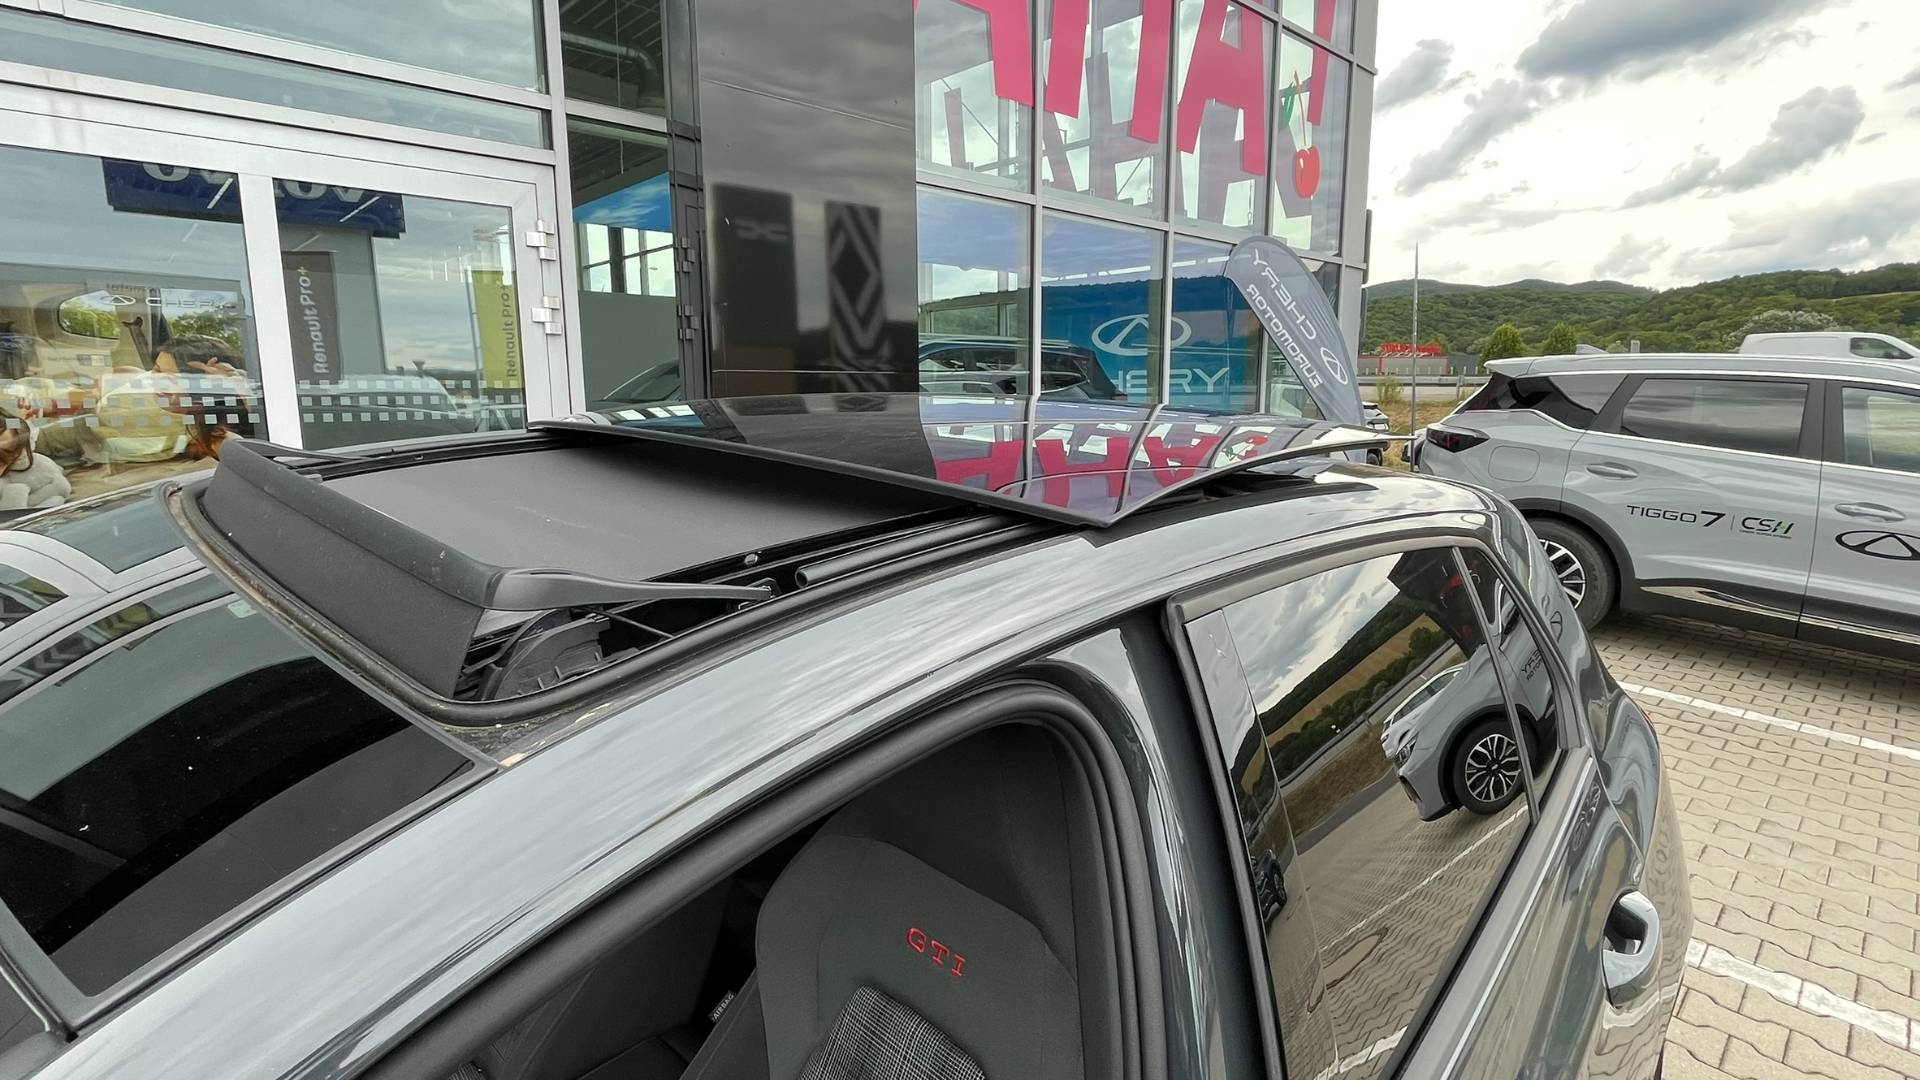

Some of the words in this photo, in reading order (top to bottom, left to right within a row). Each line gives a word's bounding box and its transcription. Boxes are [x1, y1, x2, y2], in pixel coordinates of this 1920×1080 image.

[303, 306, 329, 374] Renault
[502, 321, 517, 377] Renault
[1626, 505, 1697, 524] TIGGO
[1700, 510, 1726, 528] 7
[1741, 517, 1794, 535] CSH
[906, 927, 967, 977] GTI
[712, 992, 735, 1020] AIRBAG
